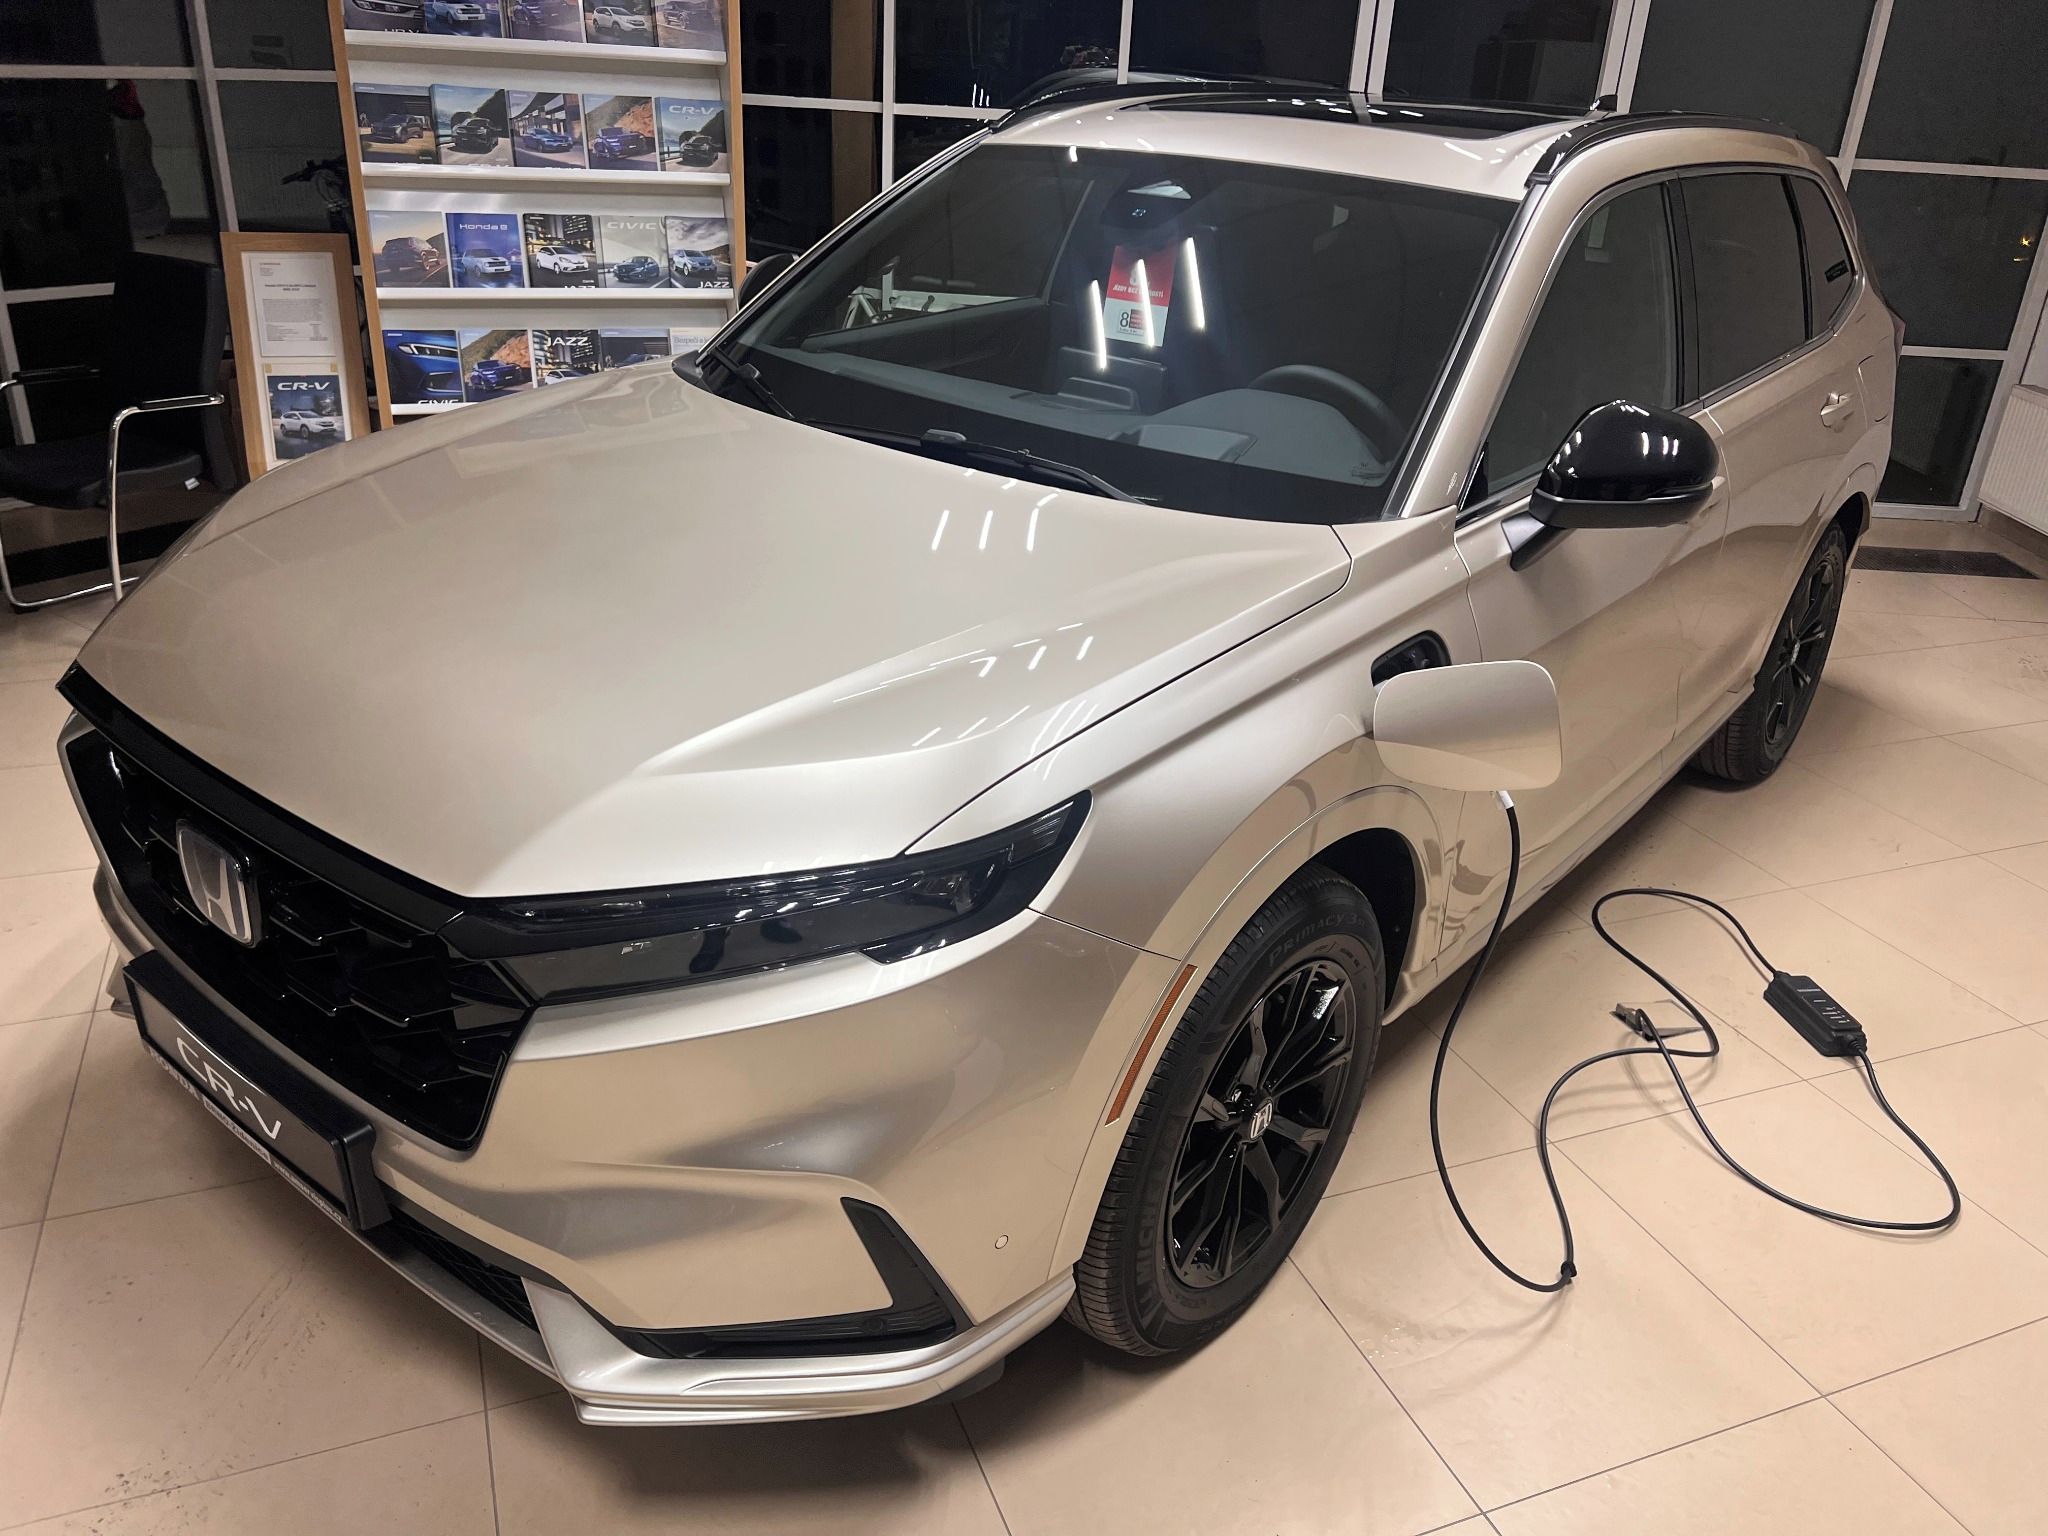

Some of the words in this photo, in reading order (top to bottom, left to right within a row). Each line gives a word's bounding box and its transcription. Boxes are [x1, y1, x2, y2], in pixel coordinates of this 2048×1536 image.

[668, 105, 715, 115] CR-V
[607, 221, 657, 230] CIVIC
[699, 281, 730, 289] JAZZ
[1120, 312, 1129, 328] 8
[546, 336, 589, 347] JAZZ
[277, 381, 330, 391] CR-V
[176, 1036, 282, 1140] CR-V
